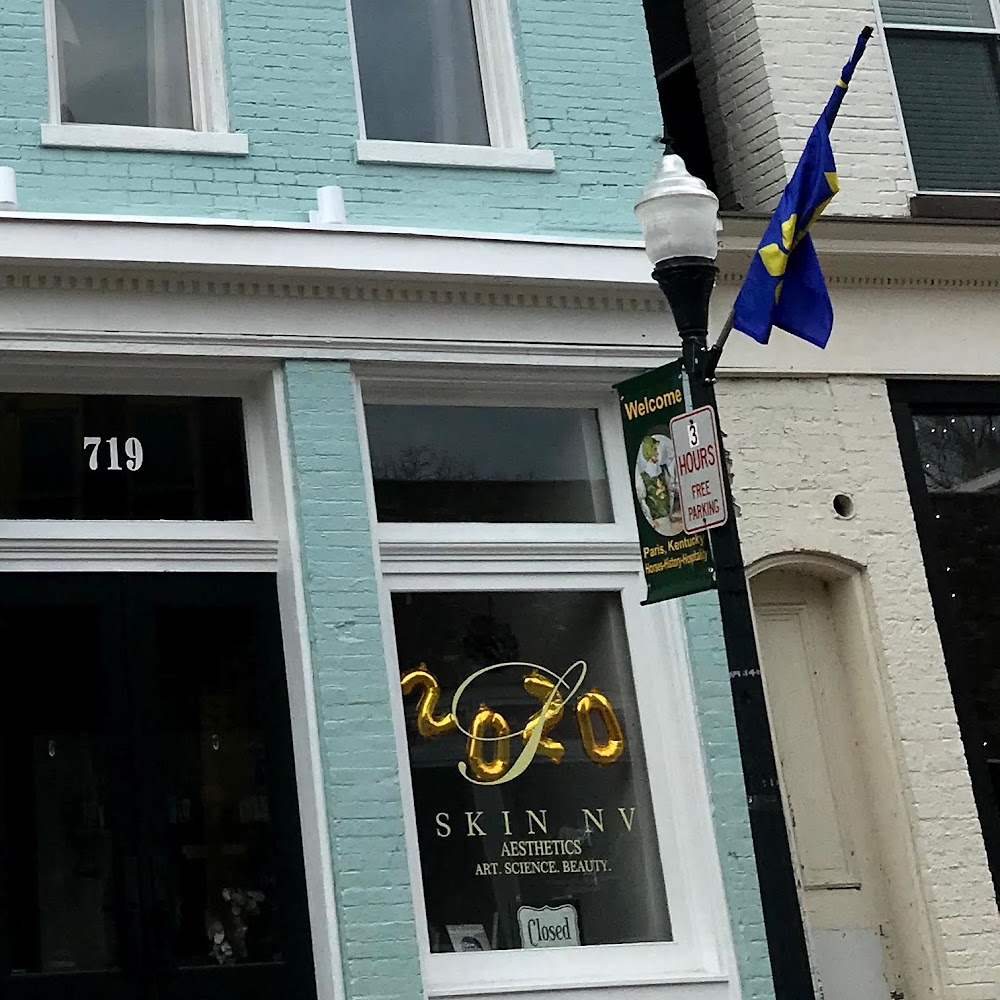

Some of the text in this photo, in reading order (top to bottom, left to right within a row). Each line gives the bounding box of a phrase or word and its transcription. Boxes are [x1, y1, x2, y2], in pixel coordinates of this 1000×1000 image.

[624, 389, 682, 420] Welcome
[689, 425, 698, 446] 3
[83, 436, 144, 471] 719
[678, 444, 715, 476] HOURS
[691, 480, 712, 499] FREE
[688, 499, 720, 521] PARKING
[643, 534, 704, 559] Paris, Kentucky
[435, 807, 636, 837] SKIN NV
[501, 839, 582, 857] AESTHETICS
[475, 859, 612, 876] ART. SCIENCE. BEAUTY.
[528, 917, 571, 947] Closed
